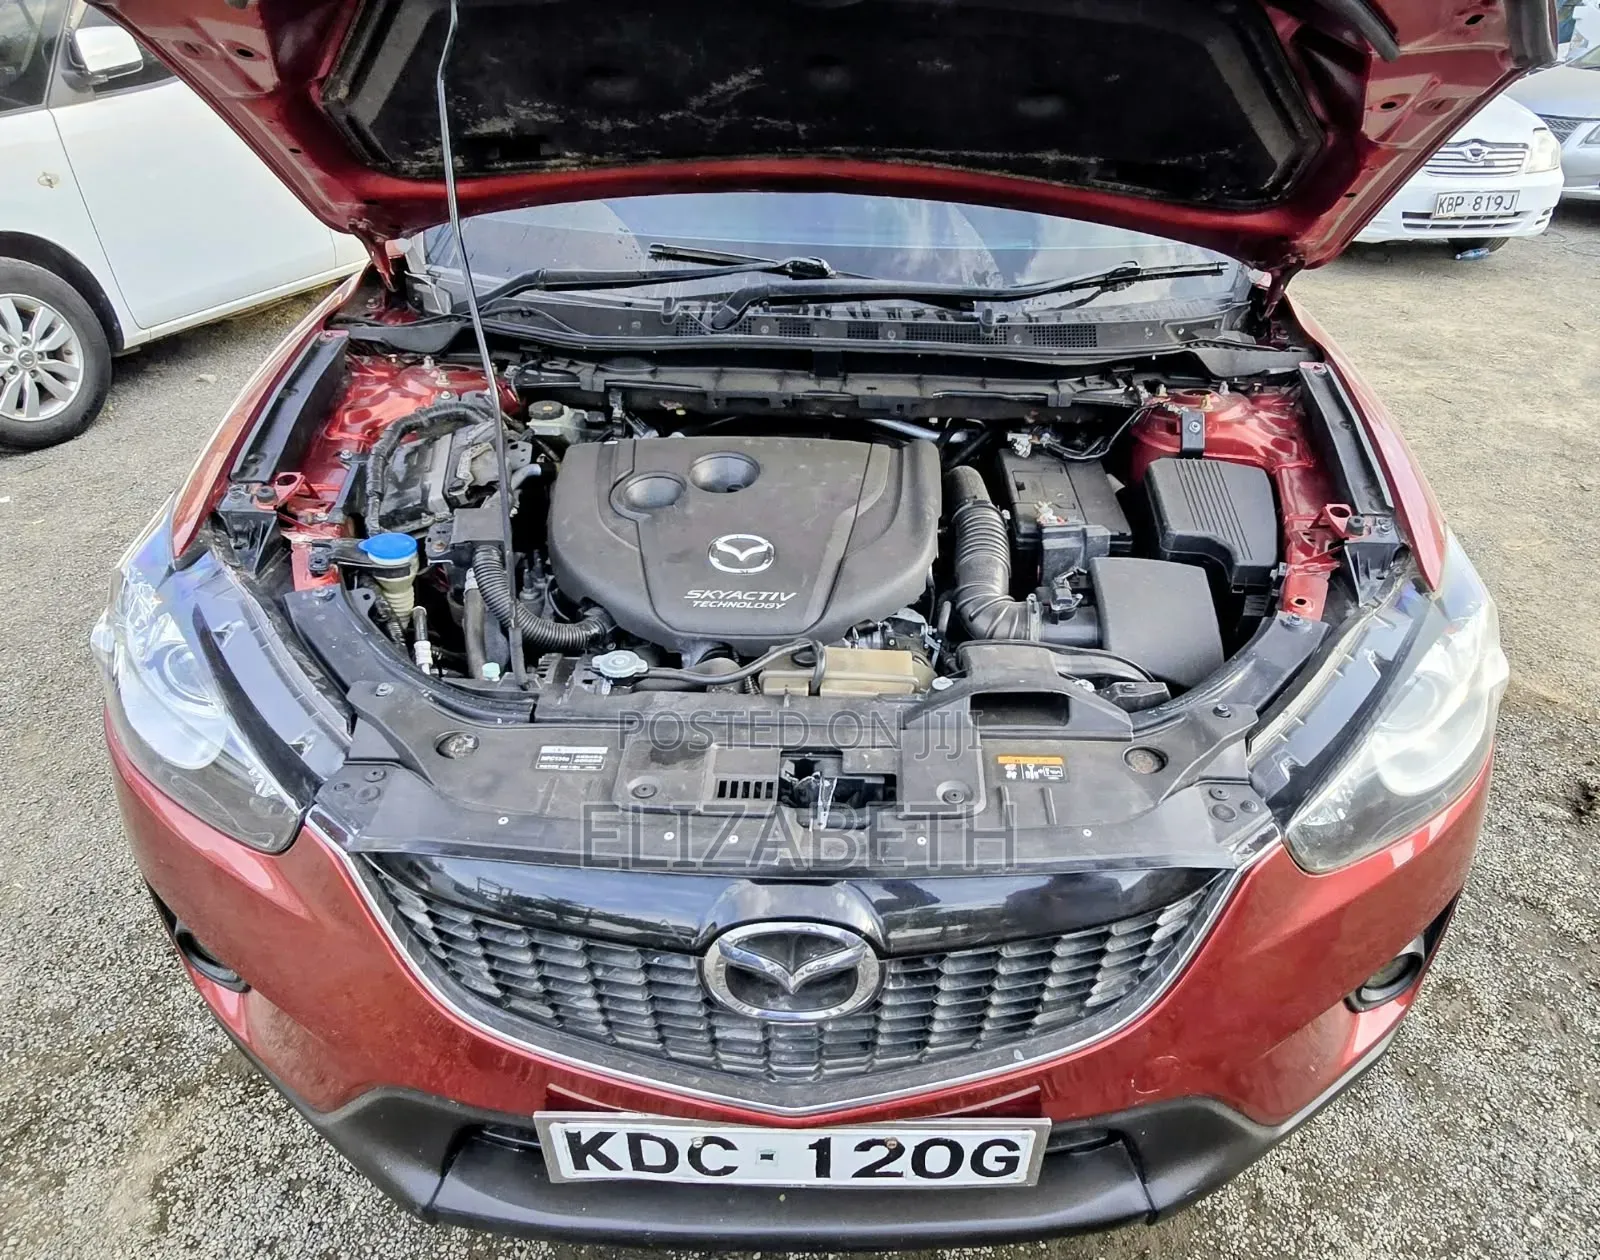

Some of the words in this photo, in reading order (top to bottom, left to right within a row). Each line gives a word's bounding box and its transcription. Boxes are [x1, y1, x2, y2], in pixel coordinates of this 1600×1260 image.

[1437, 195, 1465, 214] KBP
[1472, 193, 1516, 212] 819J
[683, 589, 798, 601] SKYACTIV
[692, 600, 787, 610] TECHNOLOGY
[565, 1130, 740, 1177] KDC
[806, 1136, 1022, 1180] 120G
